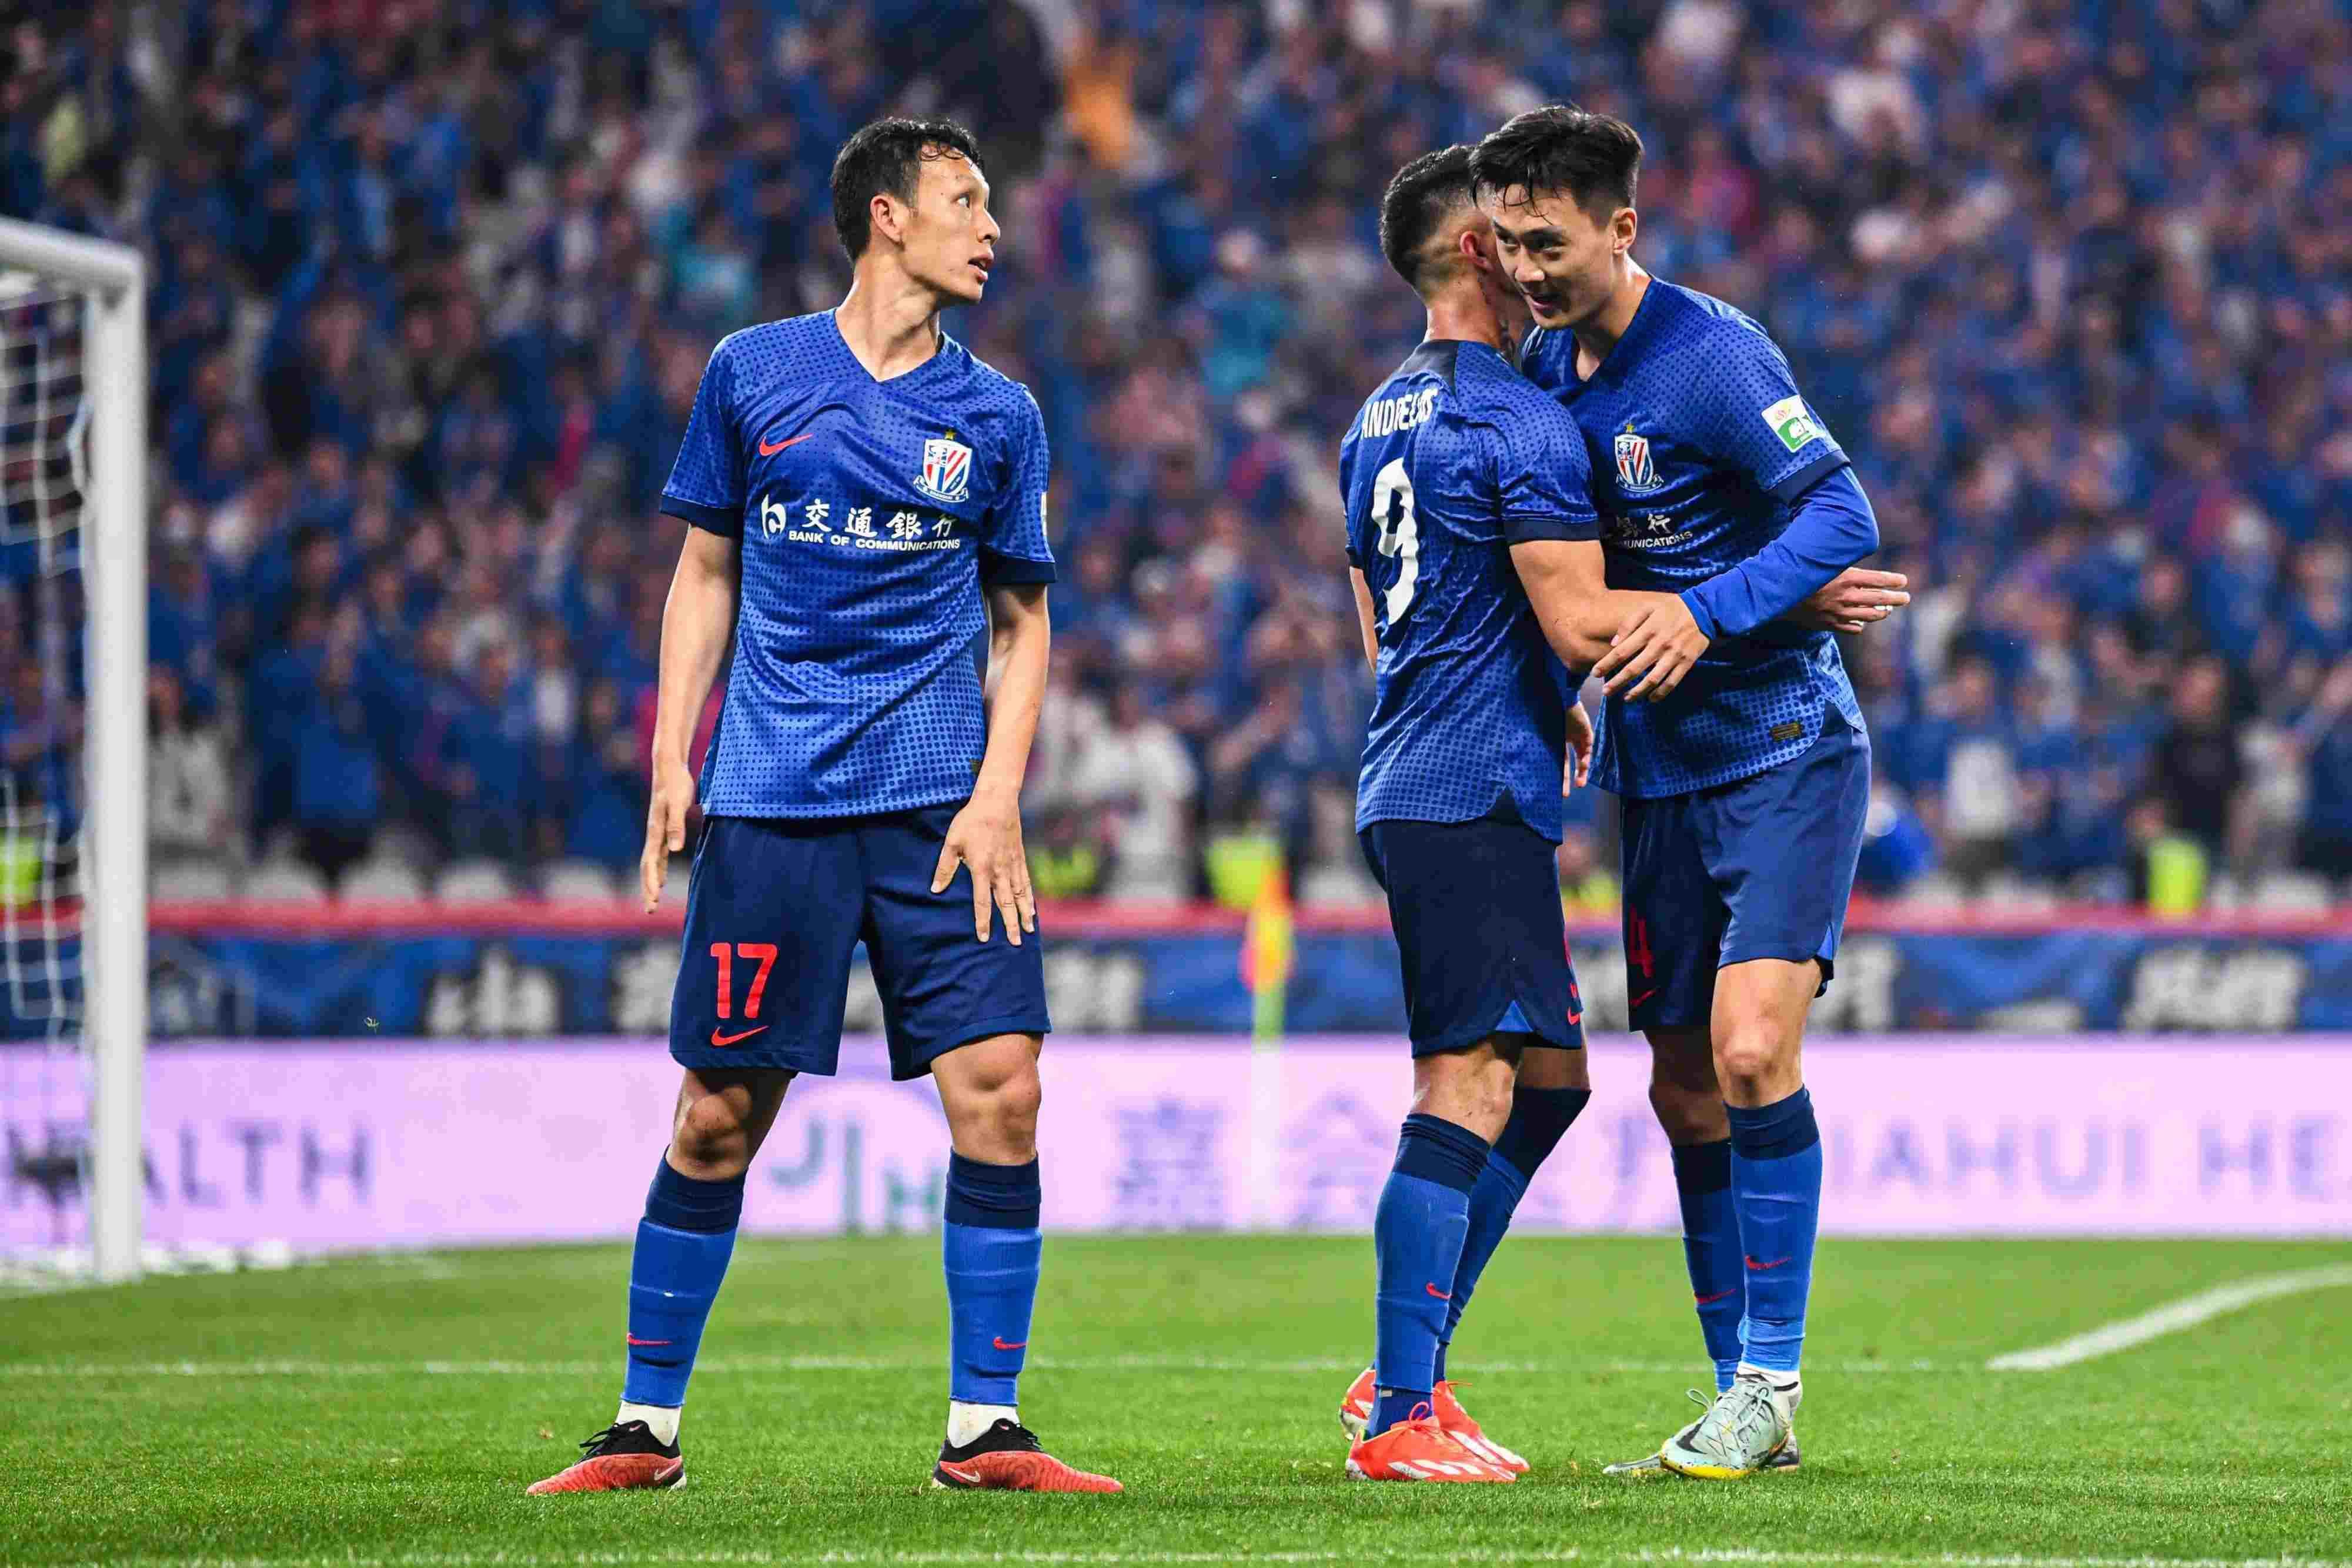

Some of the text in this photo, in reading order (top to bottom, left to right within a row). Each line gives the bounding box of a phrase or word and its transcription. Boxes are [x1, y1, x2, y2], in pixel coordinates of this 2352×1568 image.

[789, 531, 961, 551] BANK OF COMMUNICATIONS
[802, 498, 957, 540] 交通銀行
[1371, 457, 1420, 626] 9
[710, 942, 777, 1019] 17
